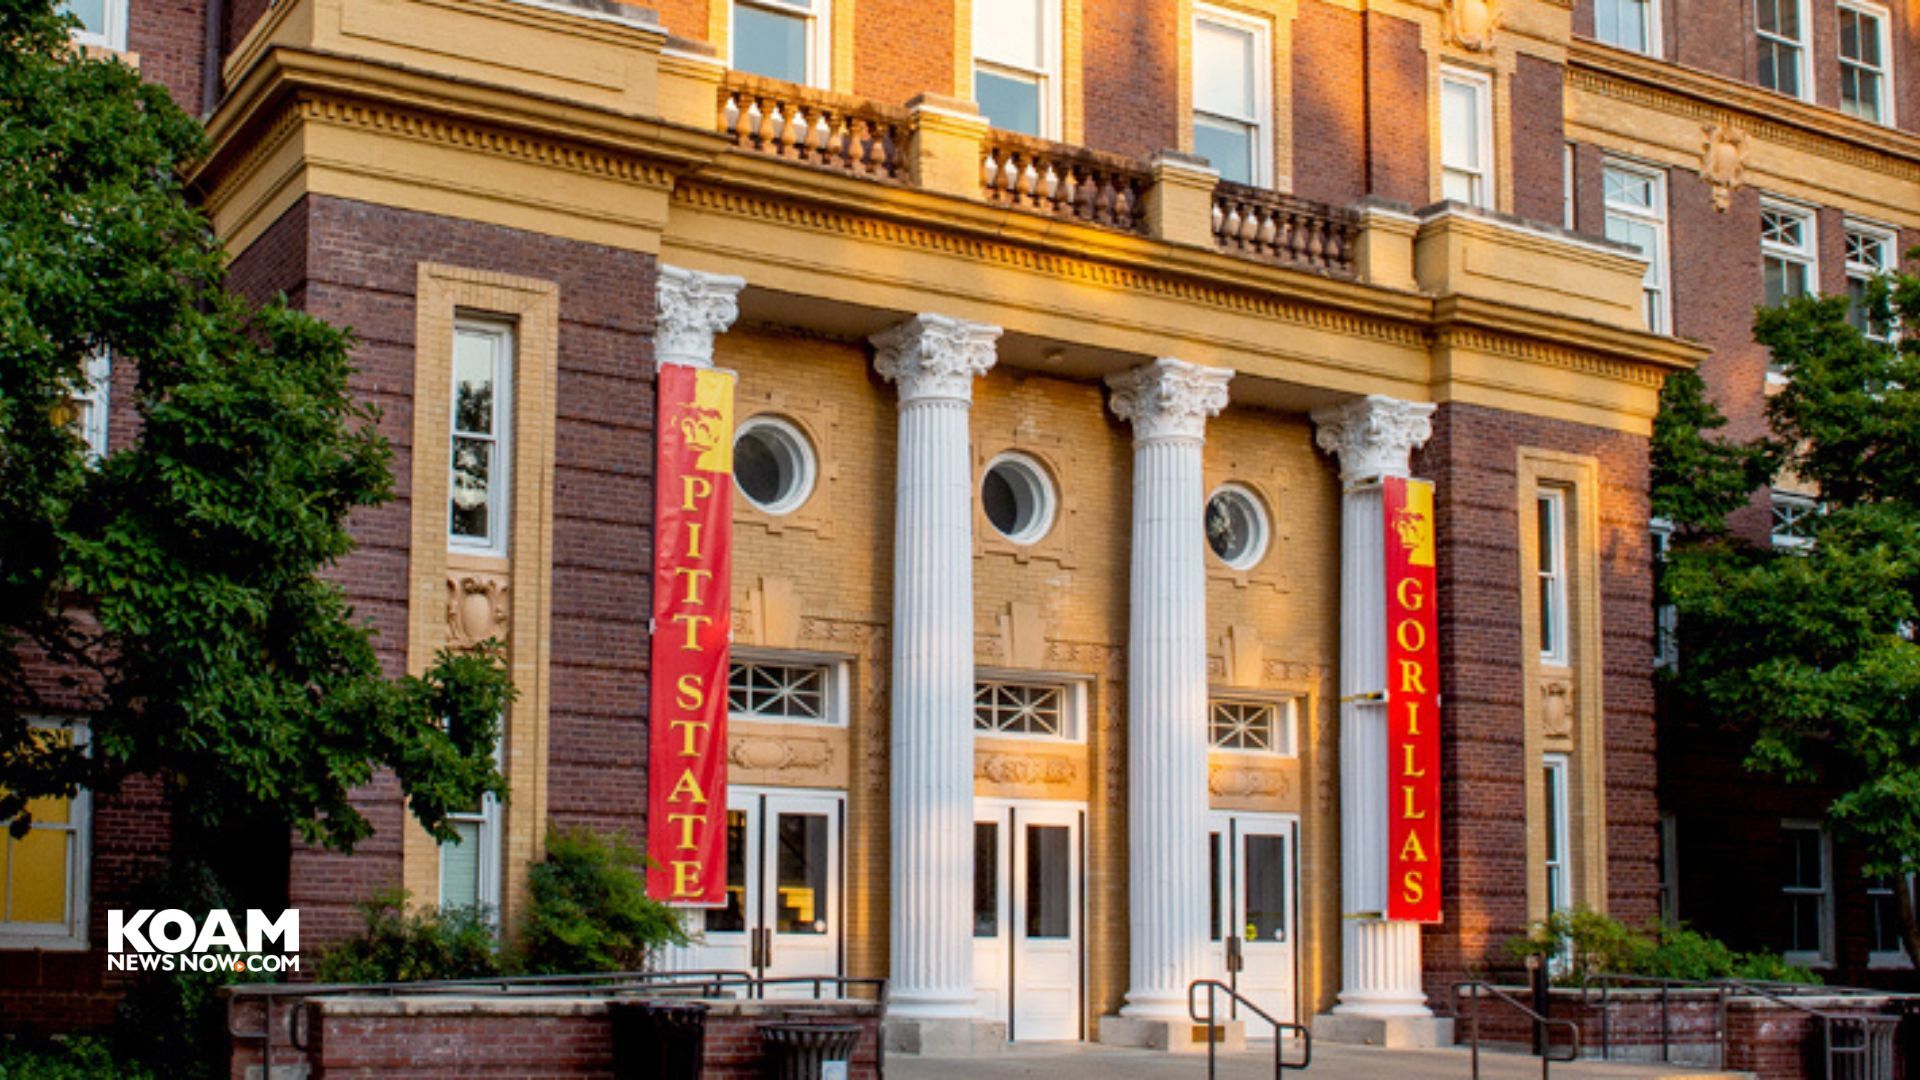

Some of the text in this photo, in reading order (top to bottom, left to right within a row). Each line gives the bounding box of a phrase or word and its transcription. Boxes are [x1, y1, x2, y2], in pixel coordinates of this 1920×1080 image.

[668, 476, 713, 898] PITT STATE
[1397, 577, 1426, 904] GORILLAS
